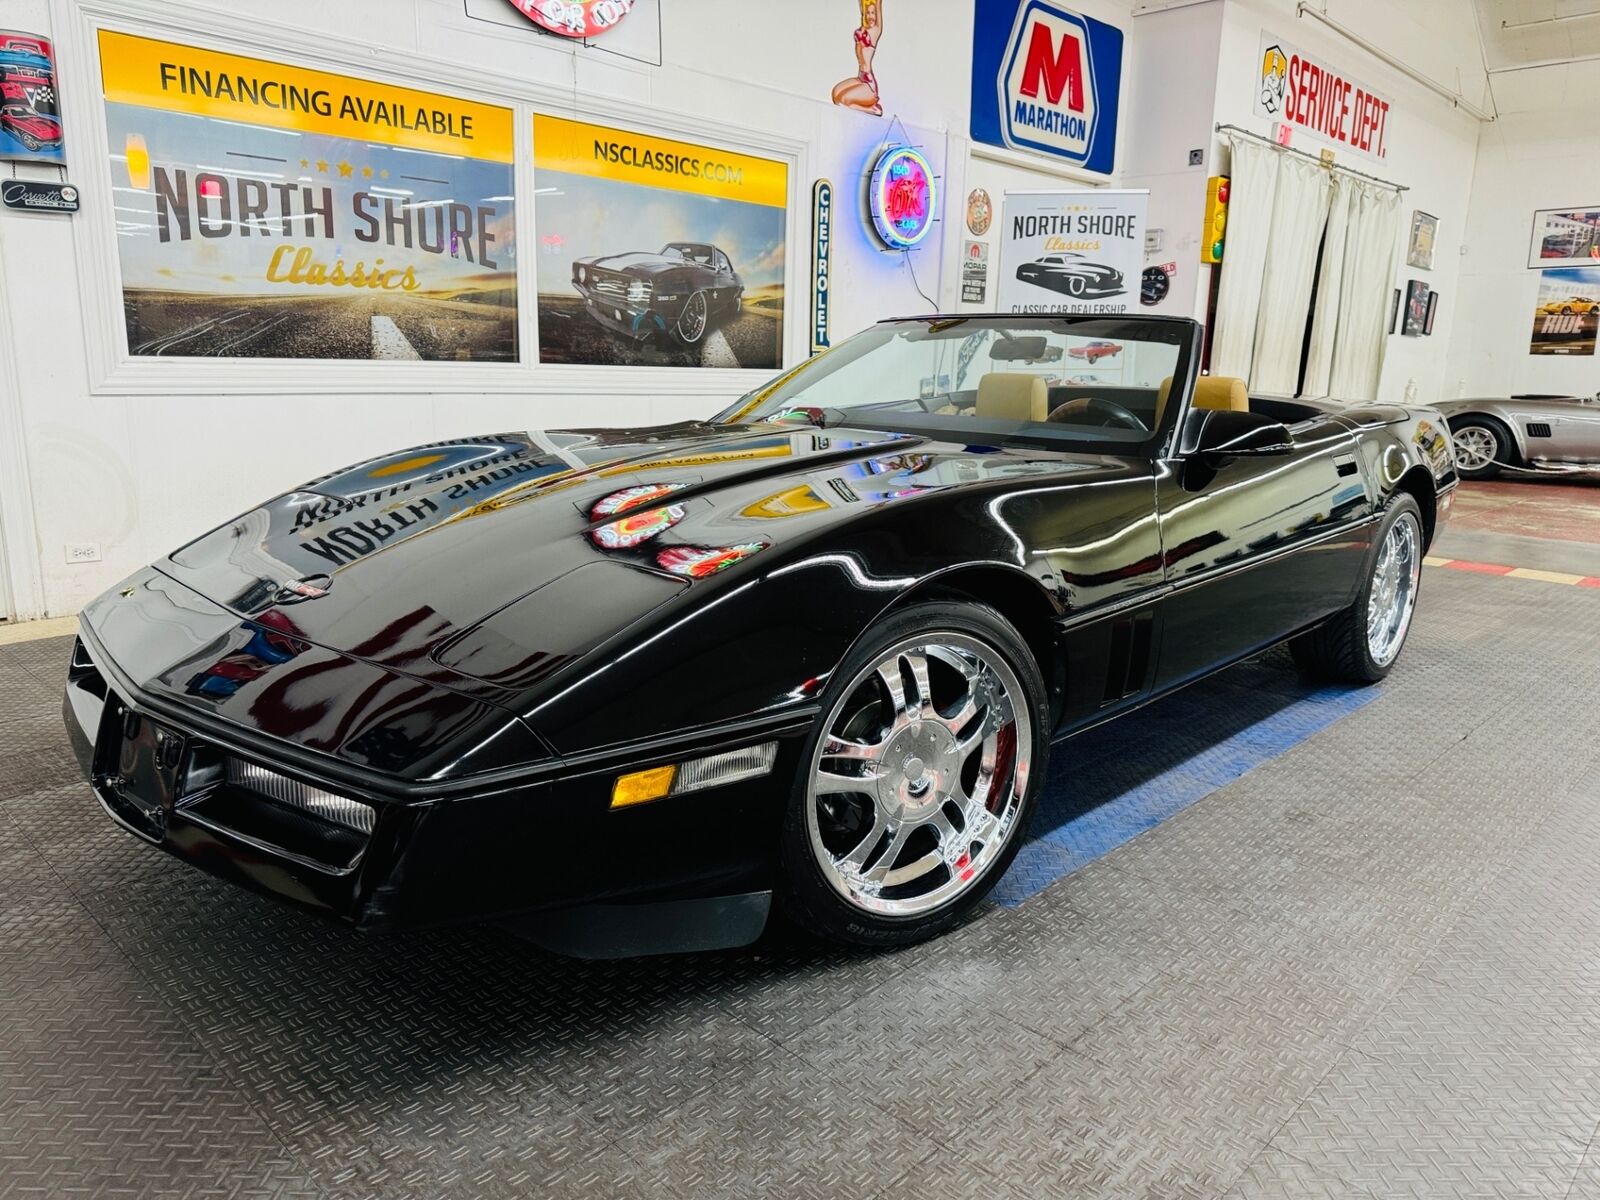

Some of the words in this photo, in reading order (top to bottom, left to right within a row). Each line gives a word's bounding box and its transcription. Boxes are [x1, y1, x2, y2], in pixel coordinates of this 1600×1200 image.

[160, 62, 331, 117] FINANCING
[339, 94, 475, 140] AVAILABLE
[1014, 100, 1086, 142] MARATHON
[1285, 54, 1352, 142] SERVICE
[1350, 88, 1390, 158] DEPT.
[593, 139, 743, 187] NSCLASSICS.COM
[3, 184, 63, 203] Corvette
[153, 166, 335, 244] NORTH
[352, 192, 498, 270] SHORE
[1012, 215, 1071, 240] NORTH
[1077, 214, 1137, 240] SHORE
[1043, 235, 1101, 251] Classics
[266, 244, 421, 292] Classics
[816, 188, 830, 343] CHEVROLET
[963, 261, 987, 271] MOPAR
[1011, 304, 1048, 315] CLASSIC
[1050, 304, 1069, 315] CAR
[1070, 304, 1127, 315] DEALERSHIP
[1540, 314, 1584, 334] RIDE
